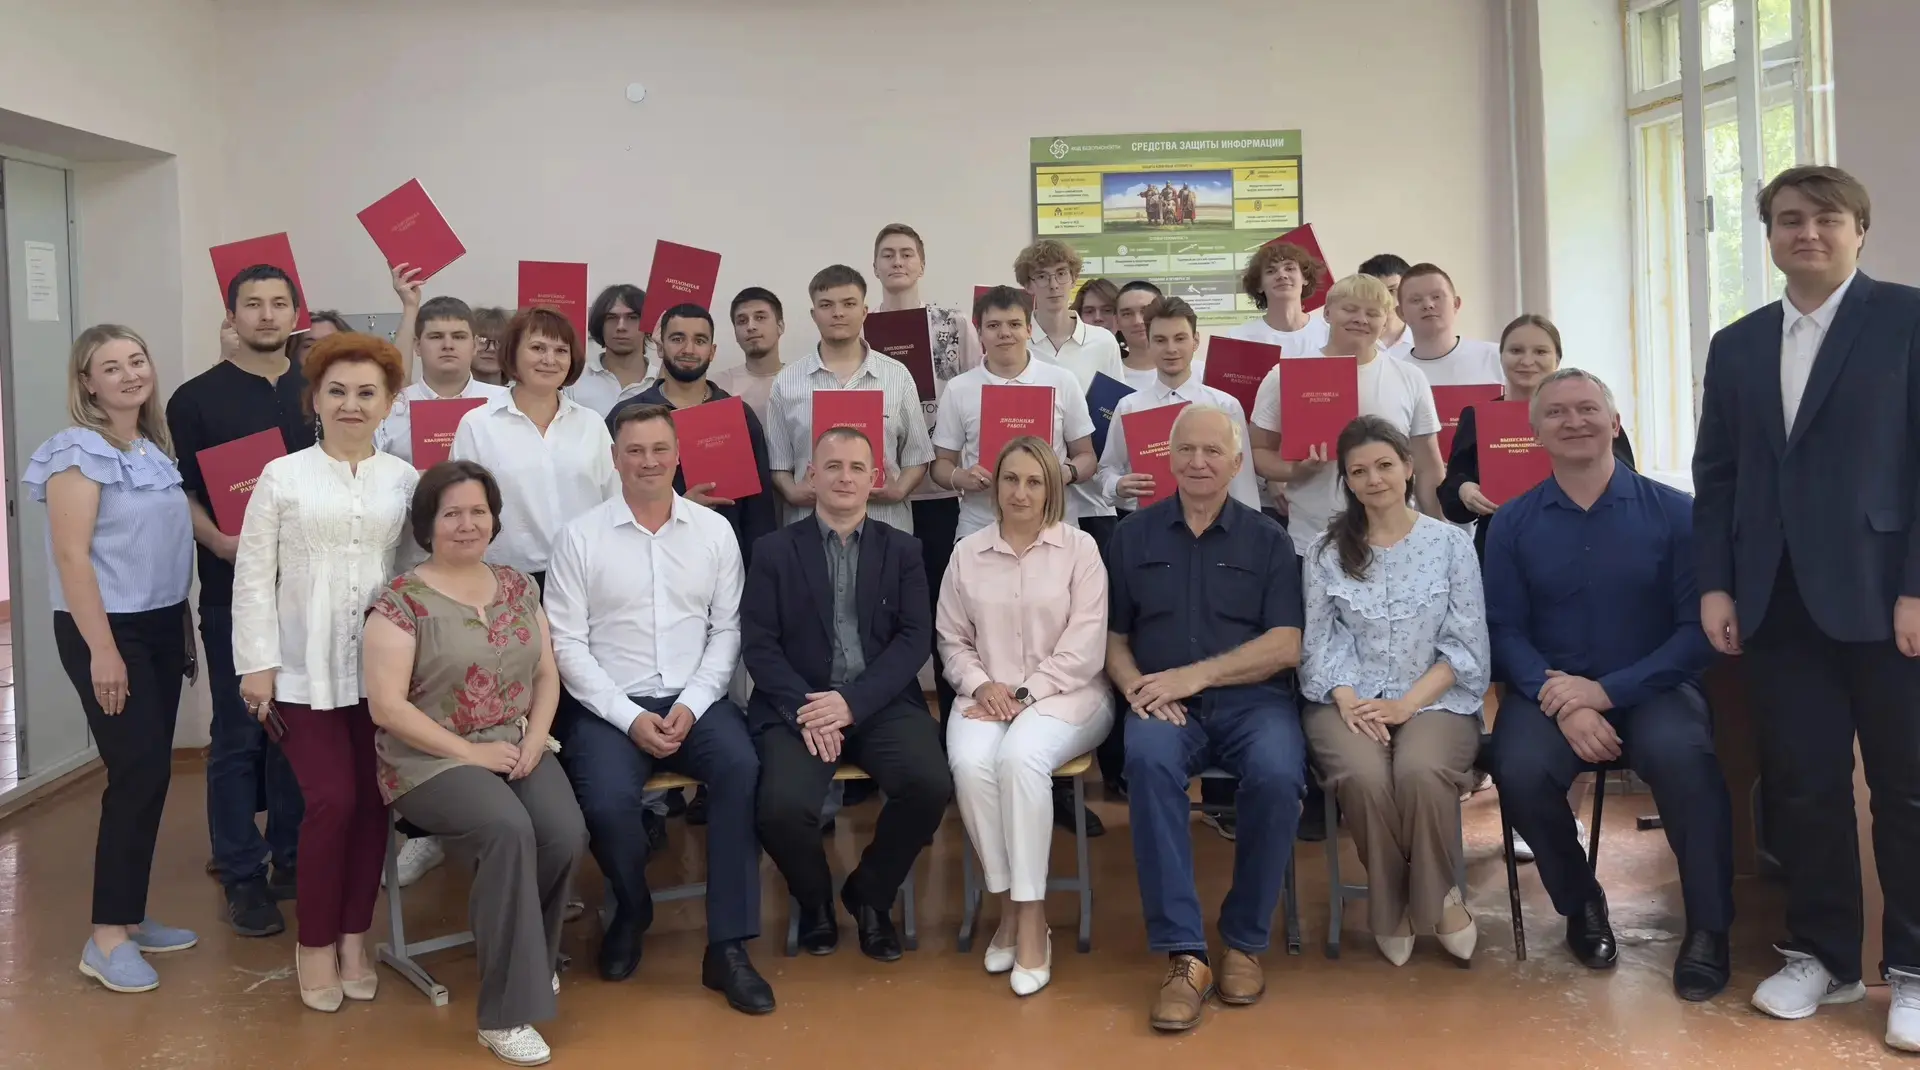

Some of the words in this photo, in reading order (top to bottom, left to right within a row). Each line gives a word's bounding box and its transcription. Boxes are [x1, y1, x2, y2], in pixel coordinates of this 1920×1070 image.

[1131, 141, 1177, 152] СРЕДСТВА
[1179, 140, 1219, 150] ЗАЩИТЫ
[1221, 138, 1284, 149] ИНФОРМАЦИИ
[665, 278, 700, 290] ДИПЛОМНАЯ
[671, 284, 692, 293] РАБОТА
[884, 344, 914, 352] ДИПЛОМНЫЙ
